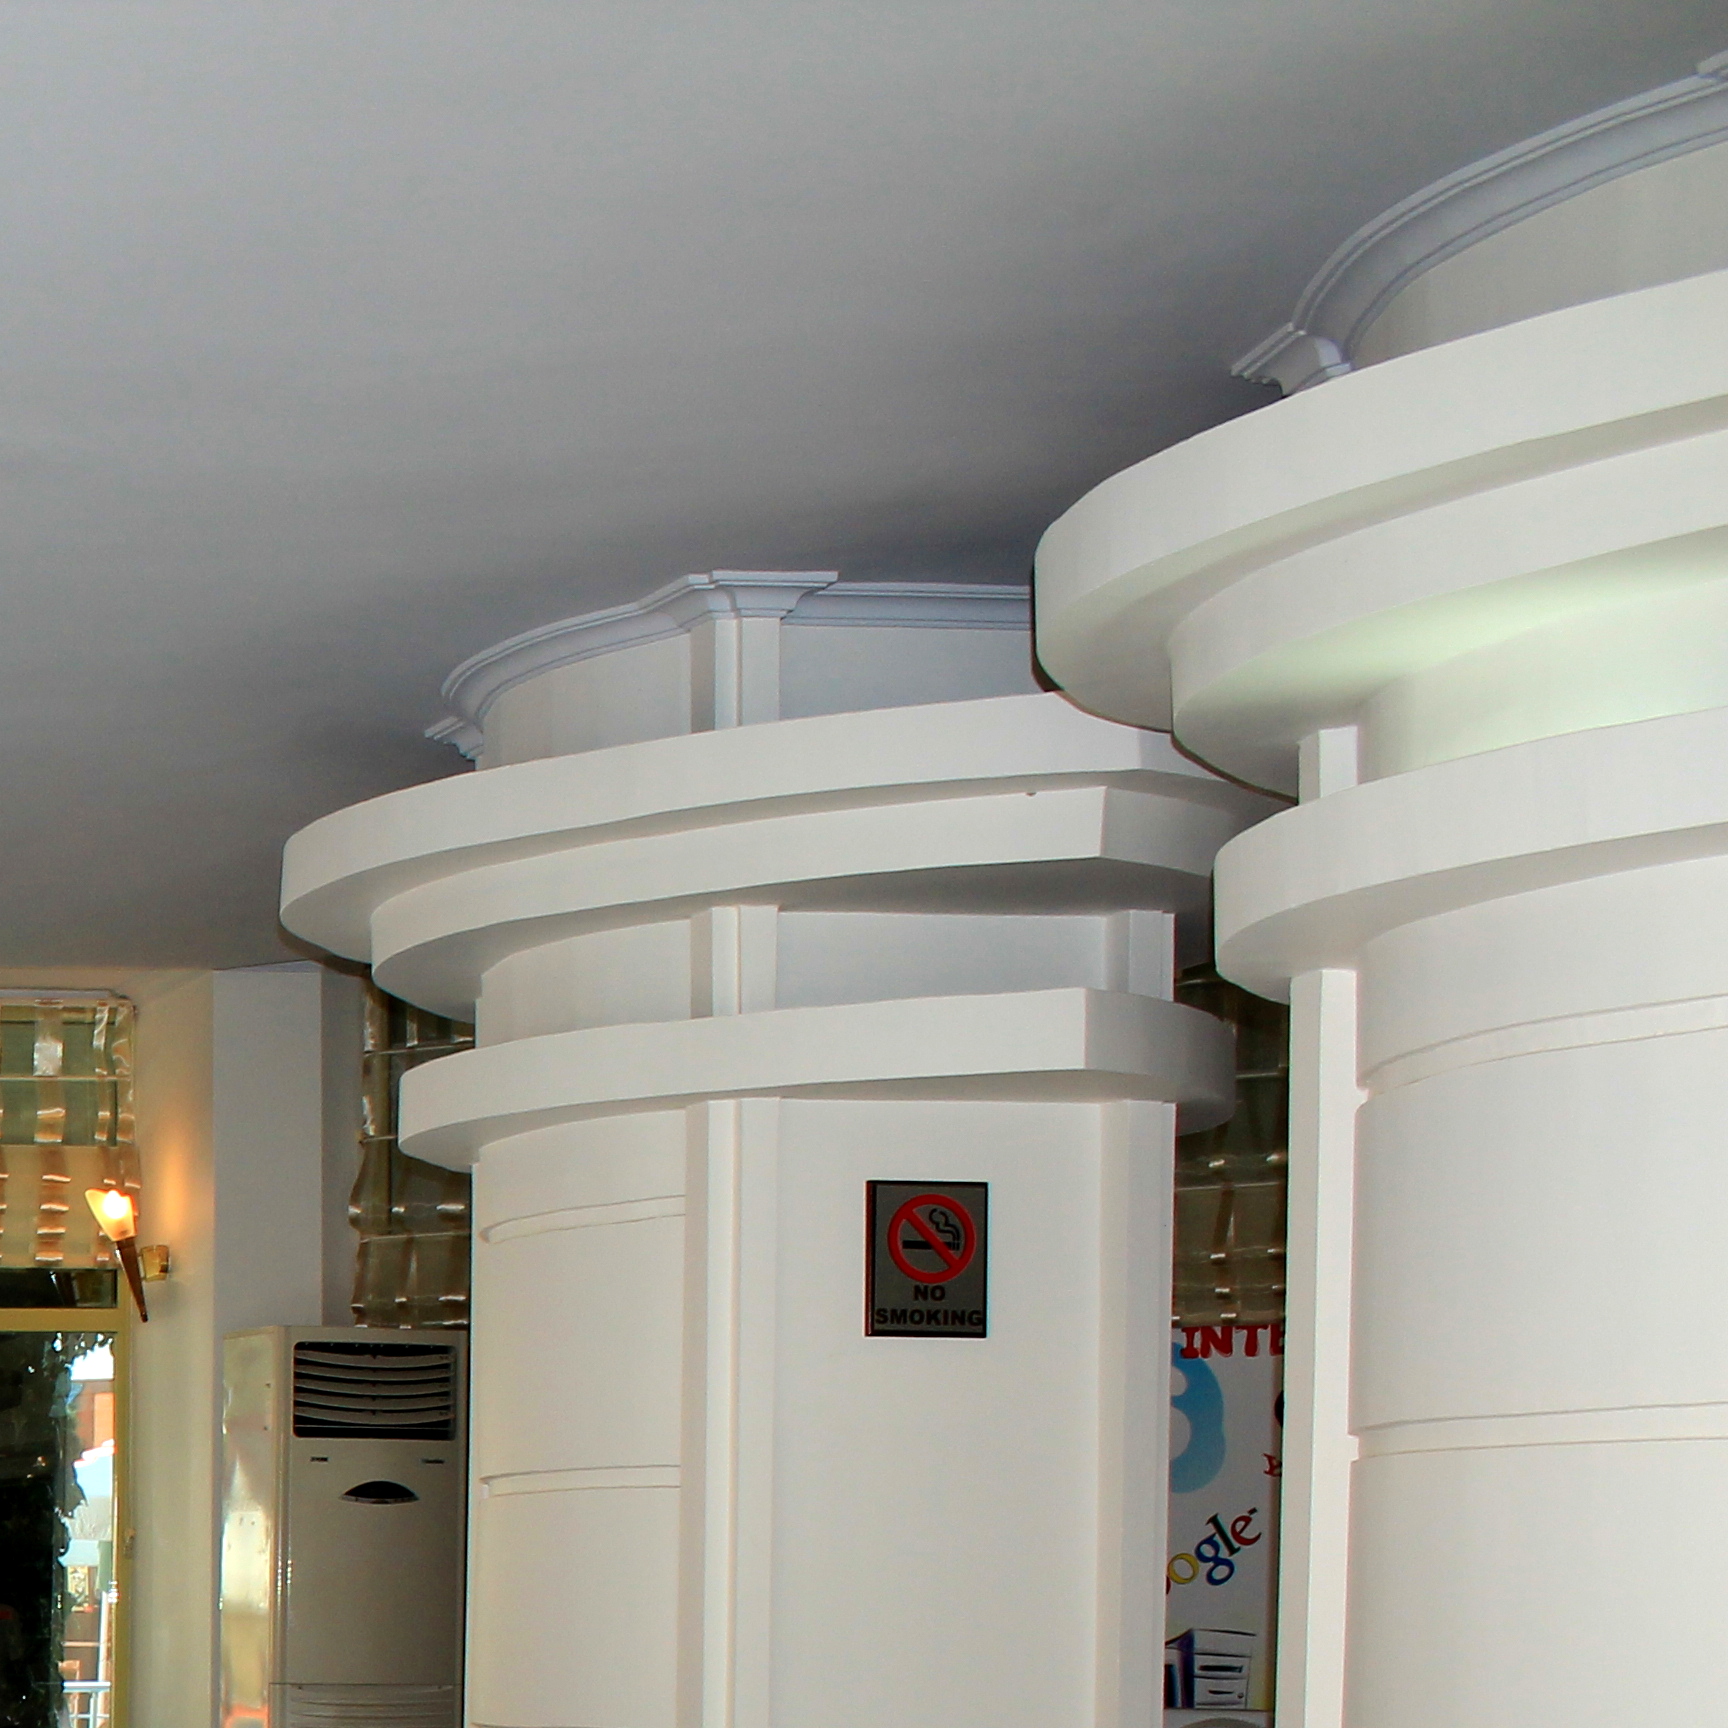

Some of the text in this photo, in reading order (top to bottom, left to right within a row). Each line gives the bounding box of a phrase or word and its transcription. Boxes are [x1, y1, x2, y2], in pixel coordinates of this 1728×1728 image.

[913, 1285, 945, 1301] NO
[875, 1307, 983, 1326] SMOKING
[1166, 1510, 1262, 1587] ogle
